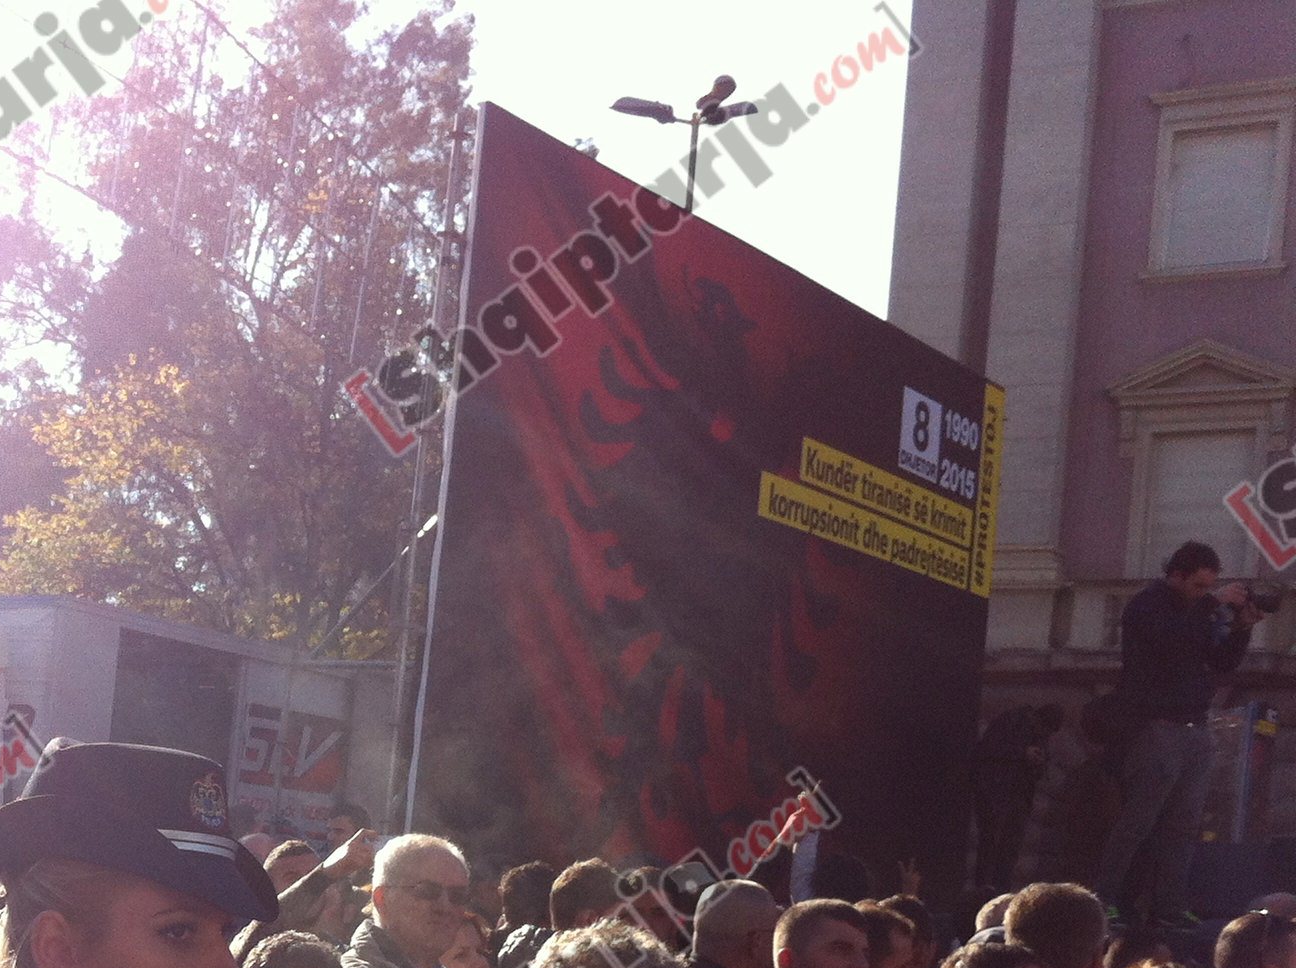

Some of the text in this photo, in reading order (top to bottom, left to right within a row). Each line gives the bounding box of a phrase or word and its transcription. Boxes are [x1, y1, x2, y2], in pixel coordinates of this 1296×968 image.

[912, 400, 930, 453] 8
[945, 408, 979, 451] 1990
[804, 446, 860, 495] Kundër
[939, 458, 976, 500] 2015
[767, 482, 861, 544] korrupsionit
[862, 520, 890, 556] dhe
